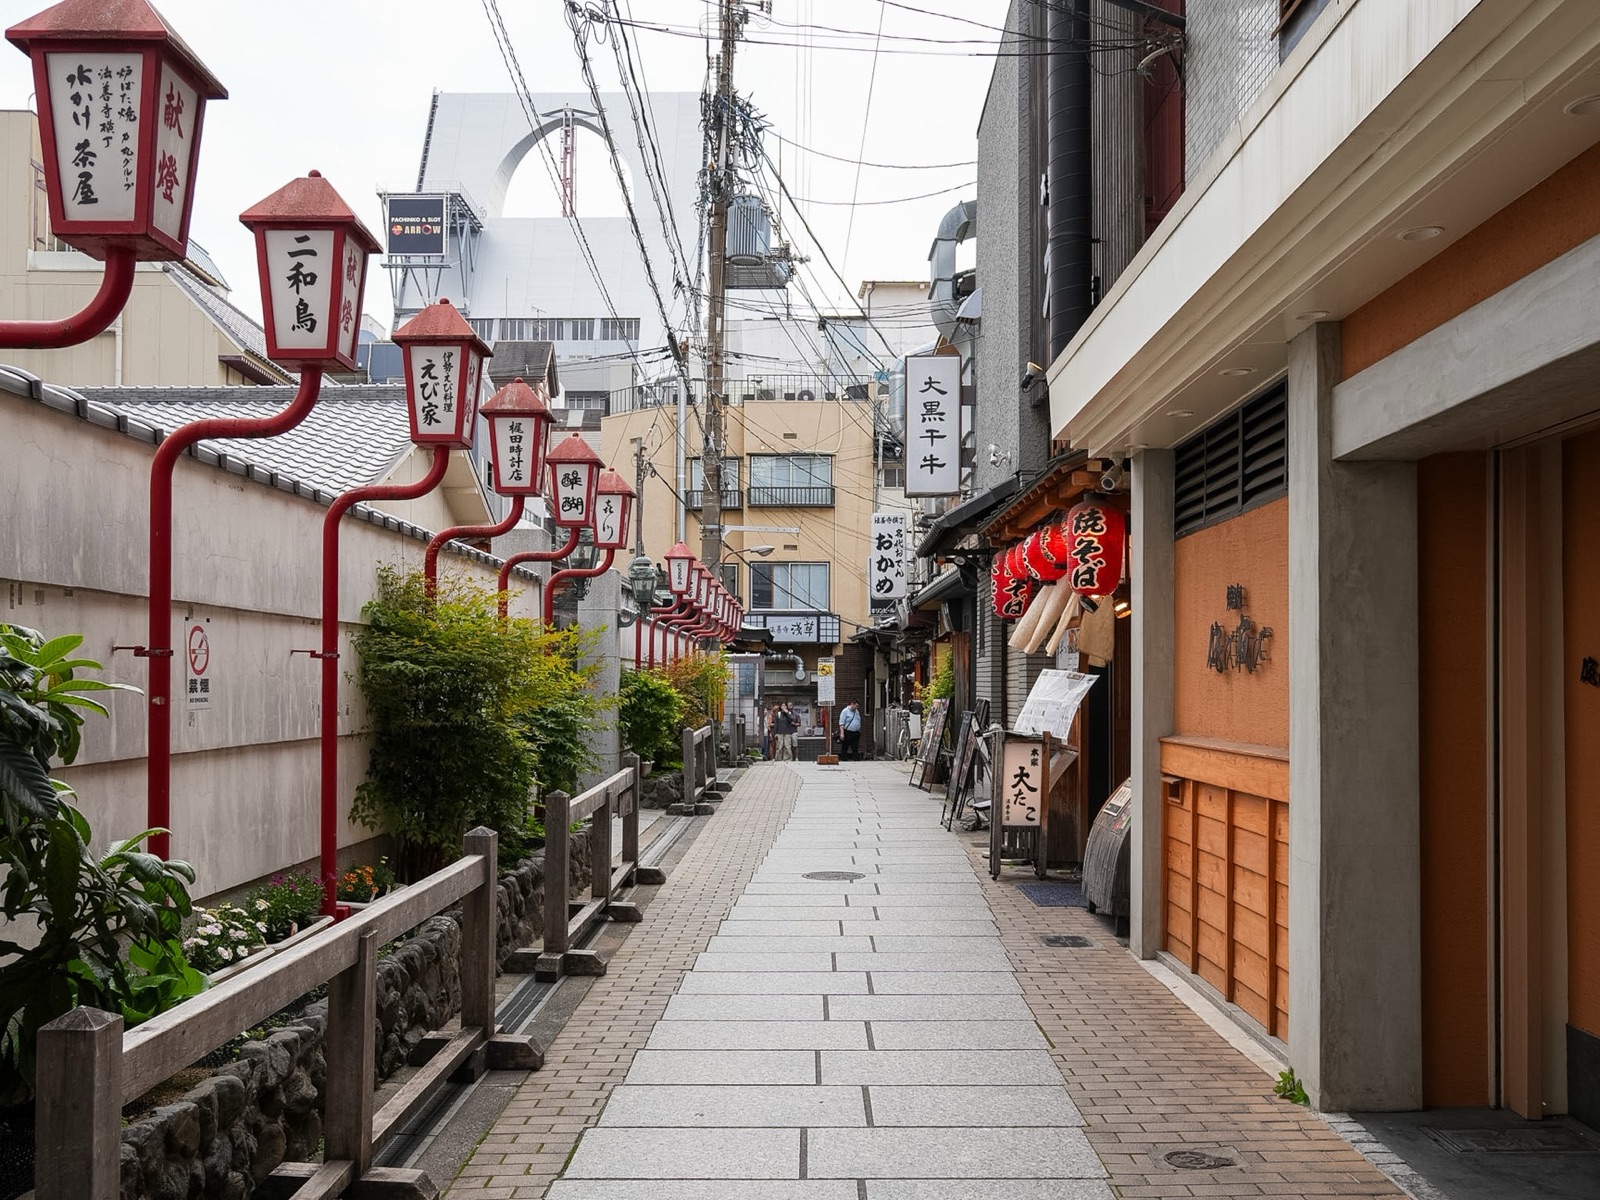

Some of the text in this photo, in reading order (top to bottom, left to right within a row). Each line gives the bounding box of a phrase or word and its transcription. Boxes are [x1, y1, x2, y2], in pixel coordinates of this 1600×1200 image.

[98, 65, 115, 148] 法善寺横丁
[116, 65, 137, 122] 炉ばた焼
[404, 224, 441, 235] ARROW
[419, 358, 442, 427] えび家
[442, 351, 454, 413] 伊勢えび料理
[508, 420, 524, 482] 梶田時計店
[875, 532, 895, 594] おかめ
[894, 528, 905, 578] 名代おでん
[1071, 506, 1109, 590] 焼そば
[188, 678, 210, 694] 禁煙
[1030, 747, 1040, 767] 本家
[1011, 766, 1038, 822] 大たこ
